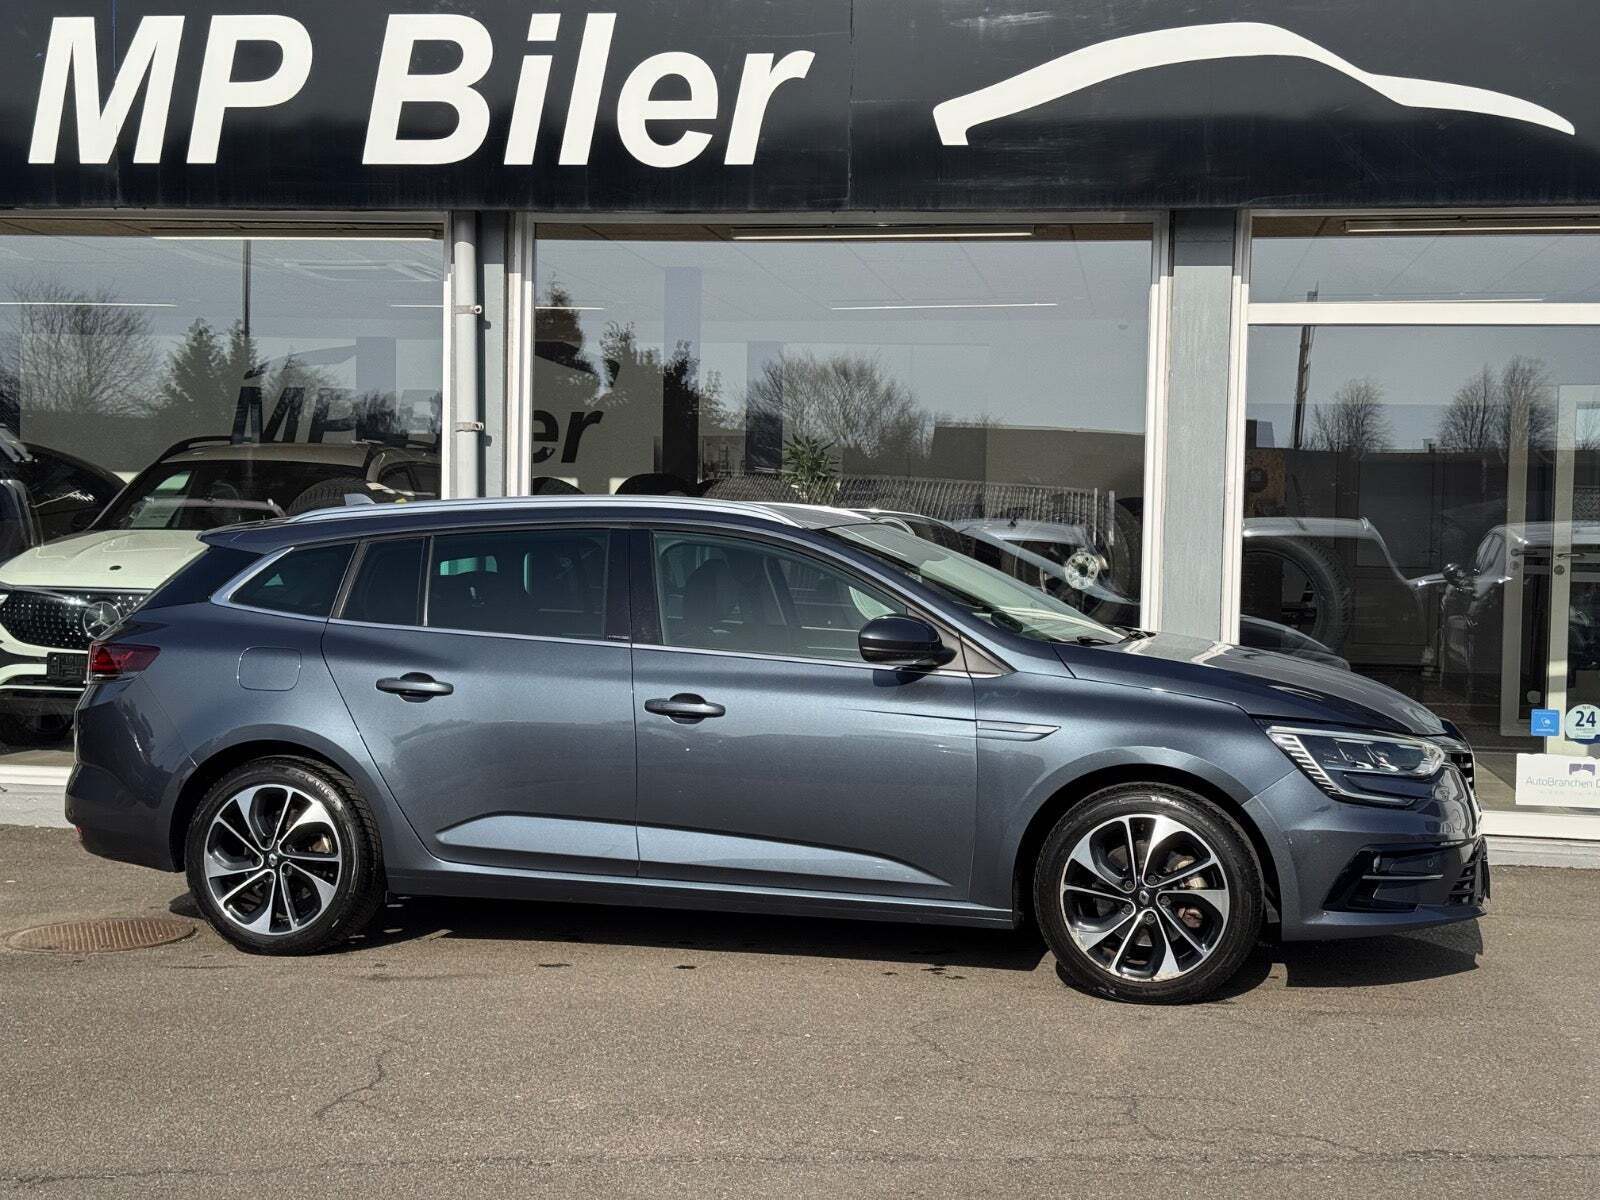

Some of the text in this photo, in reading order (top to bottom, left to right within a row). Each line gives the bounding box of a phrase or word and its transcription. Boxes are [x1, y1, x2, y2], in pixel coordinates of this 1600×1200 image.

[28, 12, 816, 168] MP Biler
[1575, 711, 1596, 727] 24
